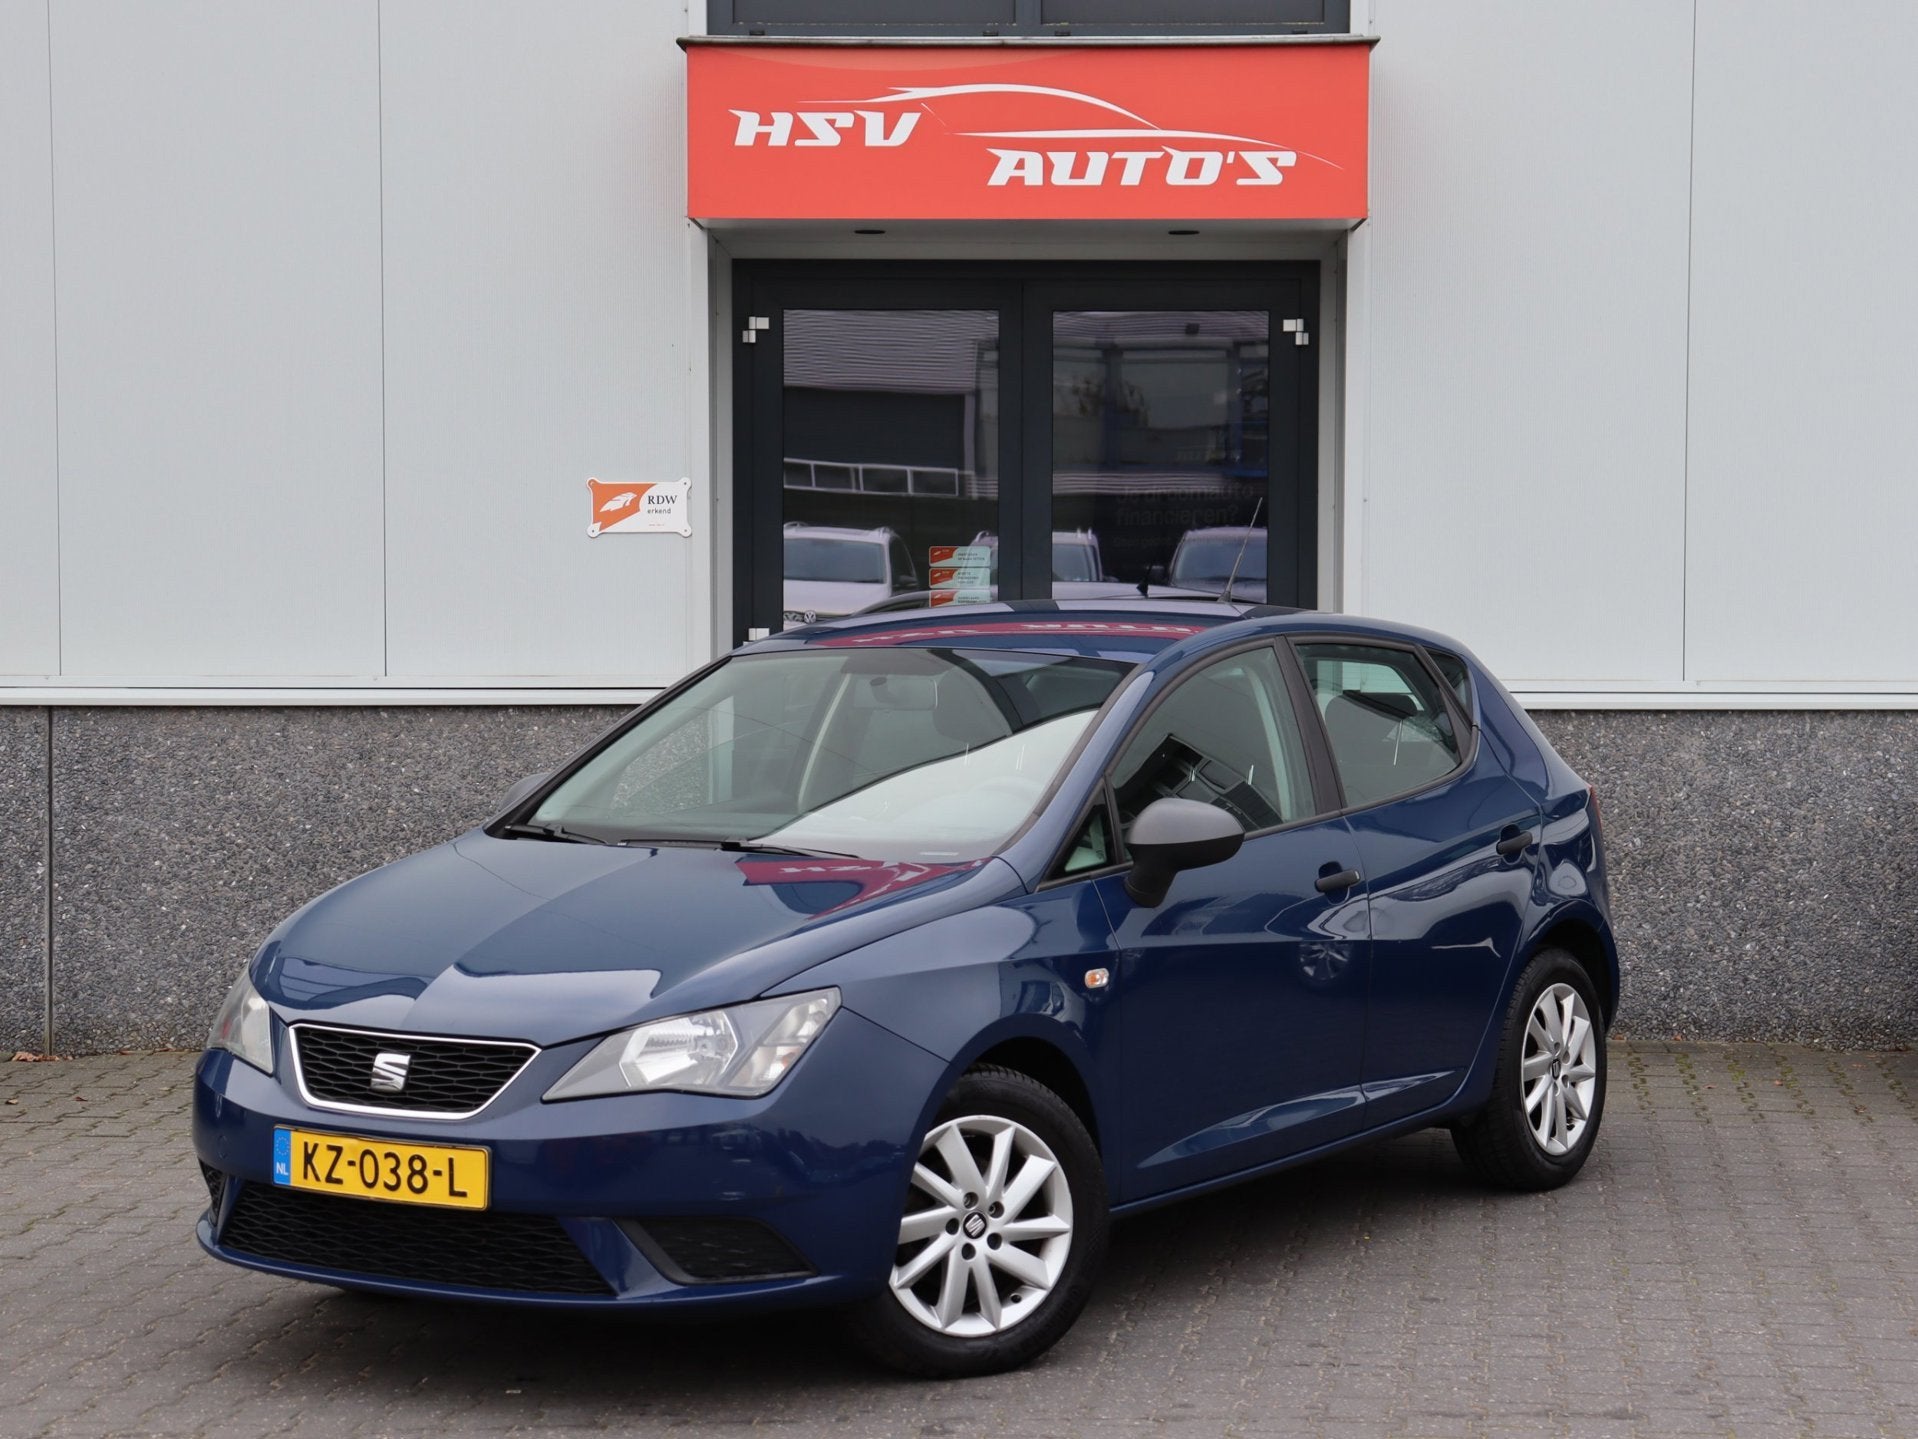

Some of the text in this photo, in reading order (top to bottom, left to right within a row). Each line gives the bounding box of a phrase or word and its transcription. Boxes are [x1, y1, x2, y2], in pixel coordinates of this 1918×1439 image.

[728, 109, 921, 147] HSV
[986, 145, 1297, 186] AUTO'S
[647, 495, 678, 505] RDW
[276, 1161, 289, 1176] NL
[303, 1141, 468, 1198] KZ-038-L
